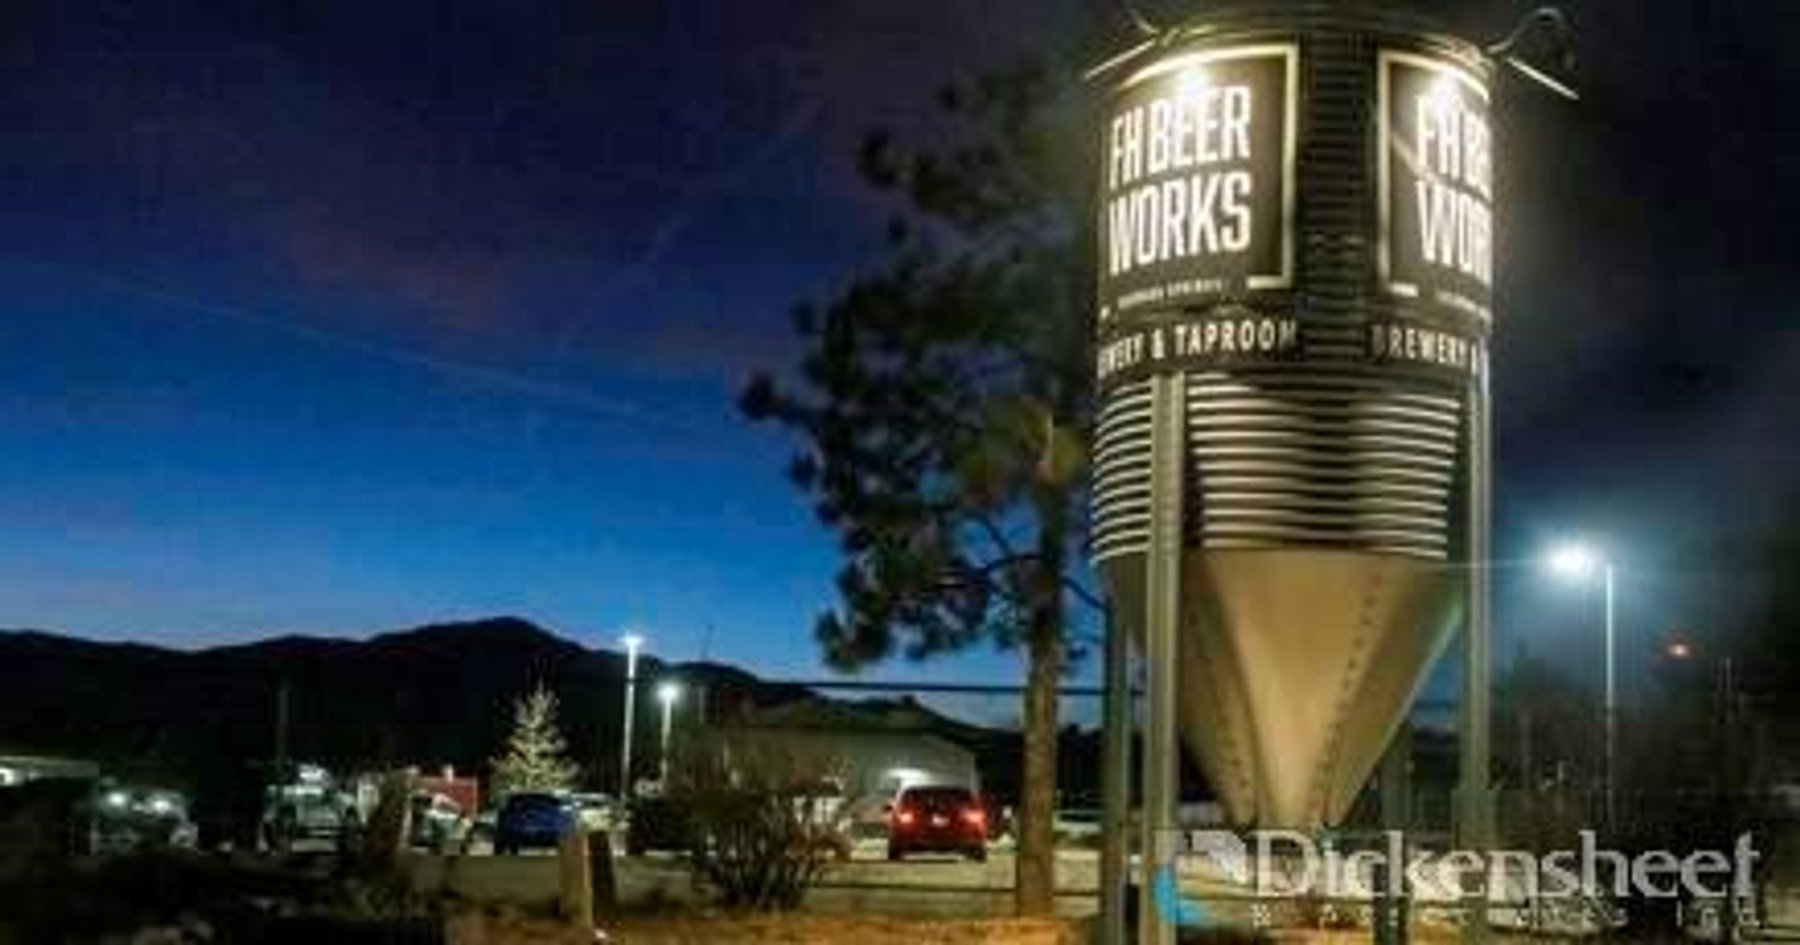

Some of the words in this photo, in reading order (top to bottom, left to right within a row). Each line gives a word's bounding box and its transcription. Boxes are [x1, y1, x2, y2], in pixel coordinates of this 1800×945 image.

[1109, 106, 1144, 191] FH
[1147, 84, 1252, 175] BEER
[1108, 171, 1252, 277] WORKS
[1174, 318, 1298, 356] TAPROOM
